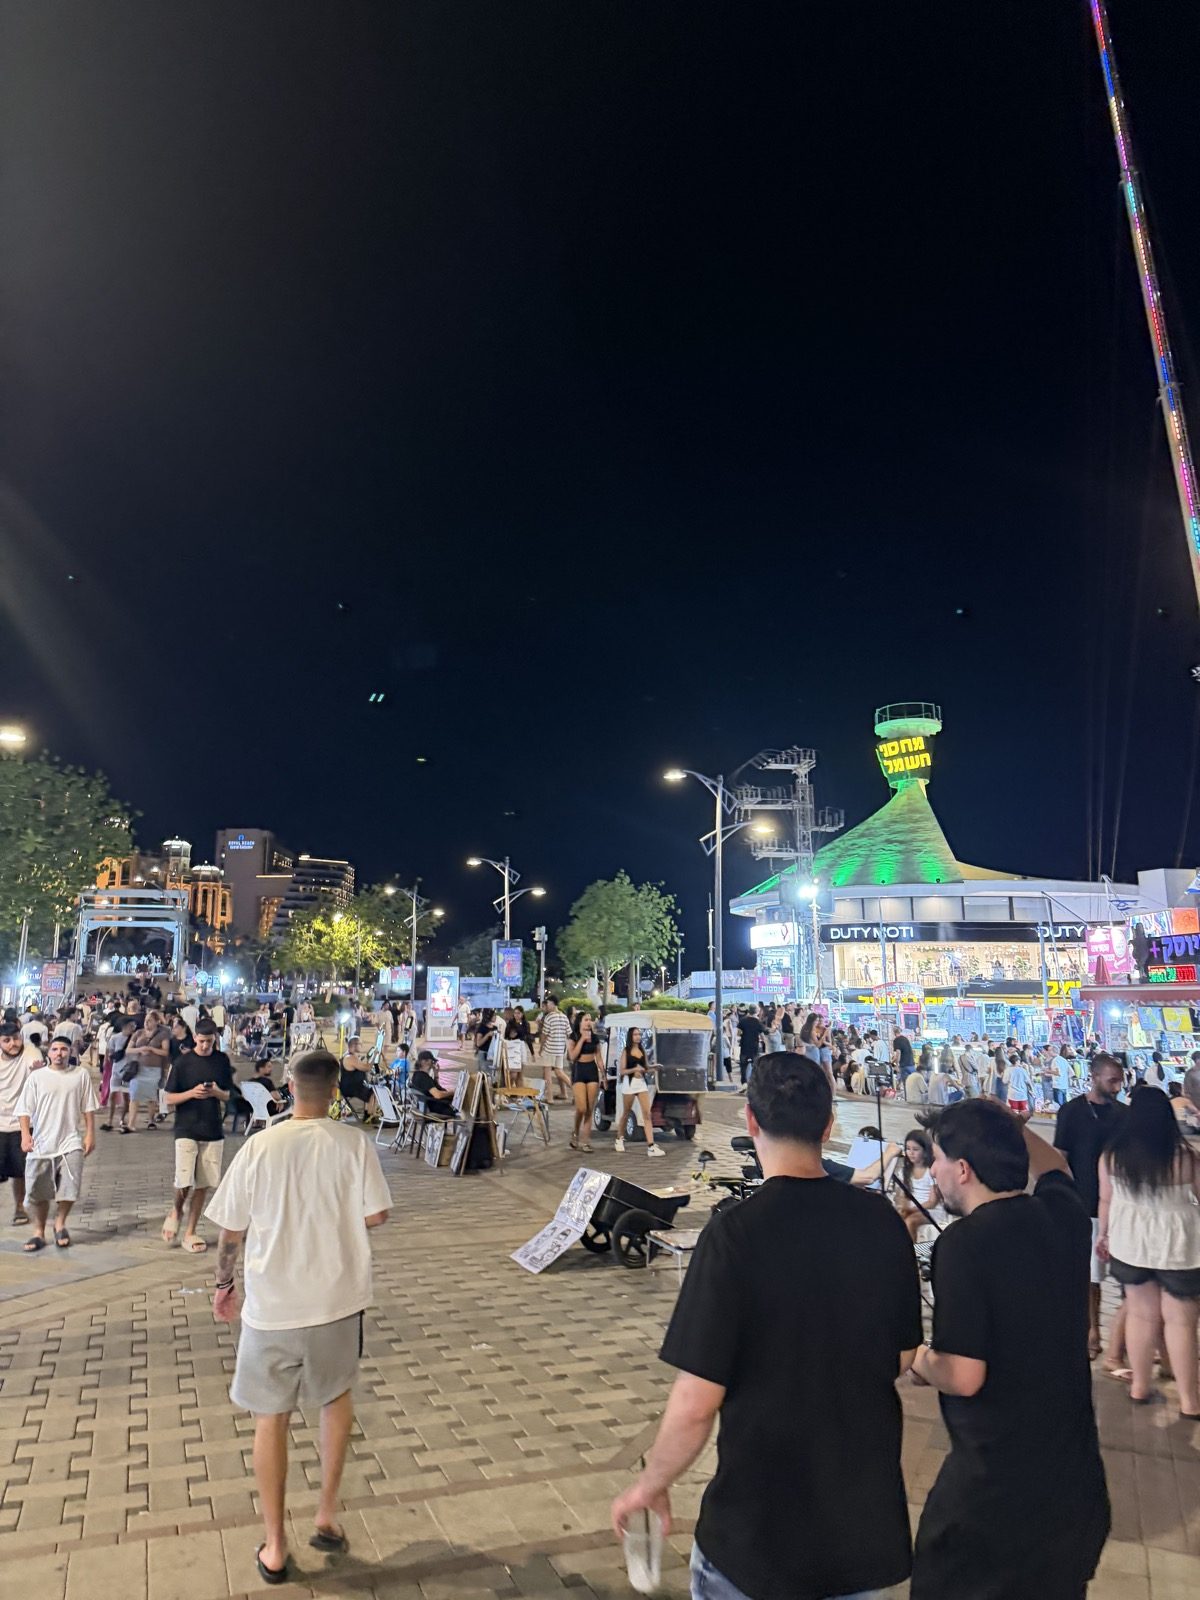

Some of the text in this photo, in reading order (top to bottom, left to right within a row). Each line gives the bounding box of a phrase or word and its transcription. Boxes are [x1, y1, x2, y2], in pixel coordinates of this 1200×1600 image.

[879, 736, 925, 758] מחסני
[883, 752, 932, 774] חשמל
[830, 926, 914, 940] DUTY MOTI
[1037, 925, 1085, 938] DUTY
